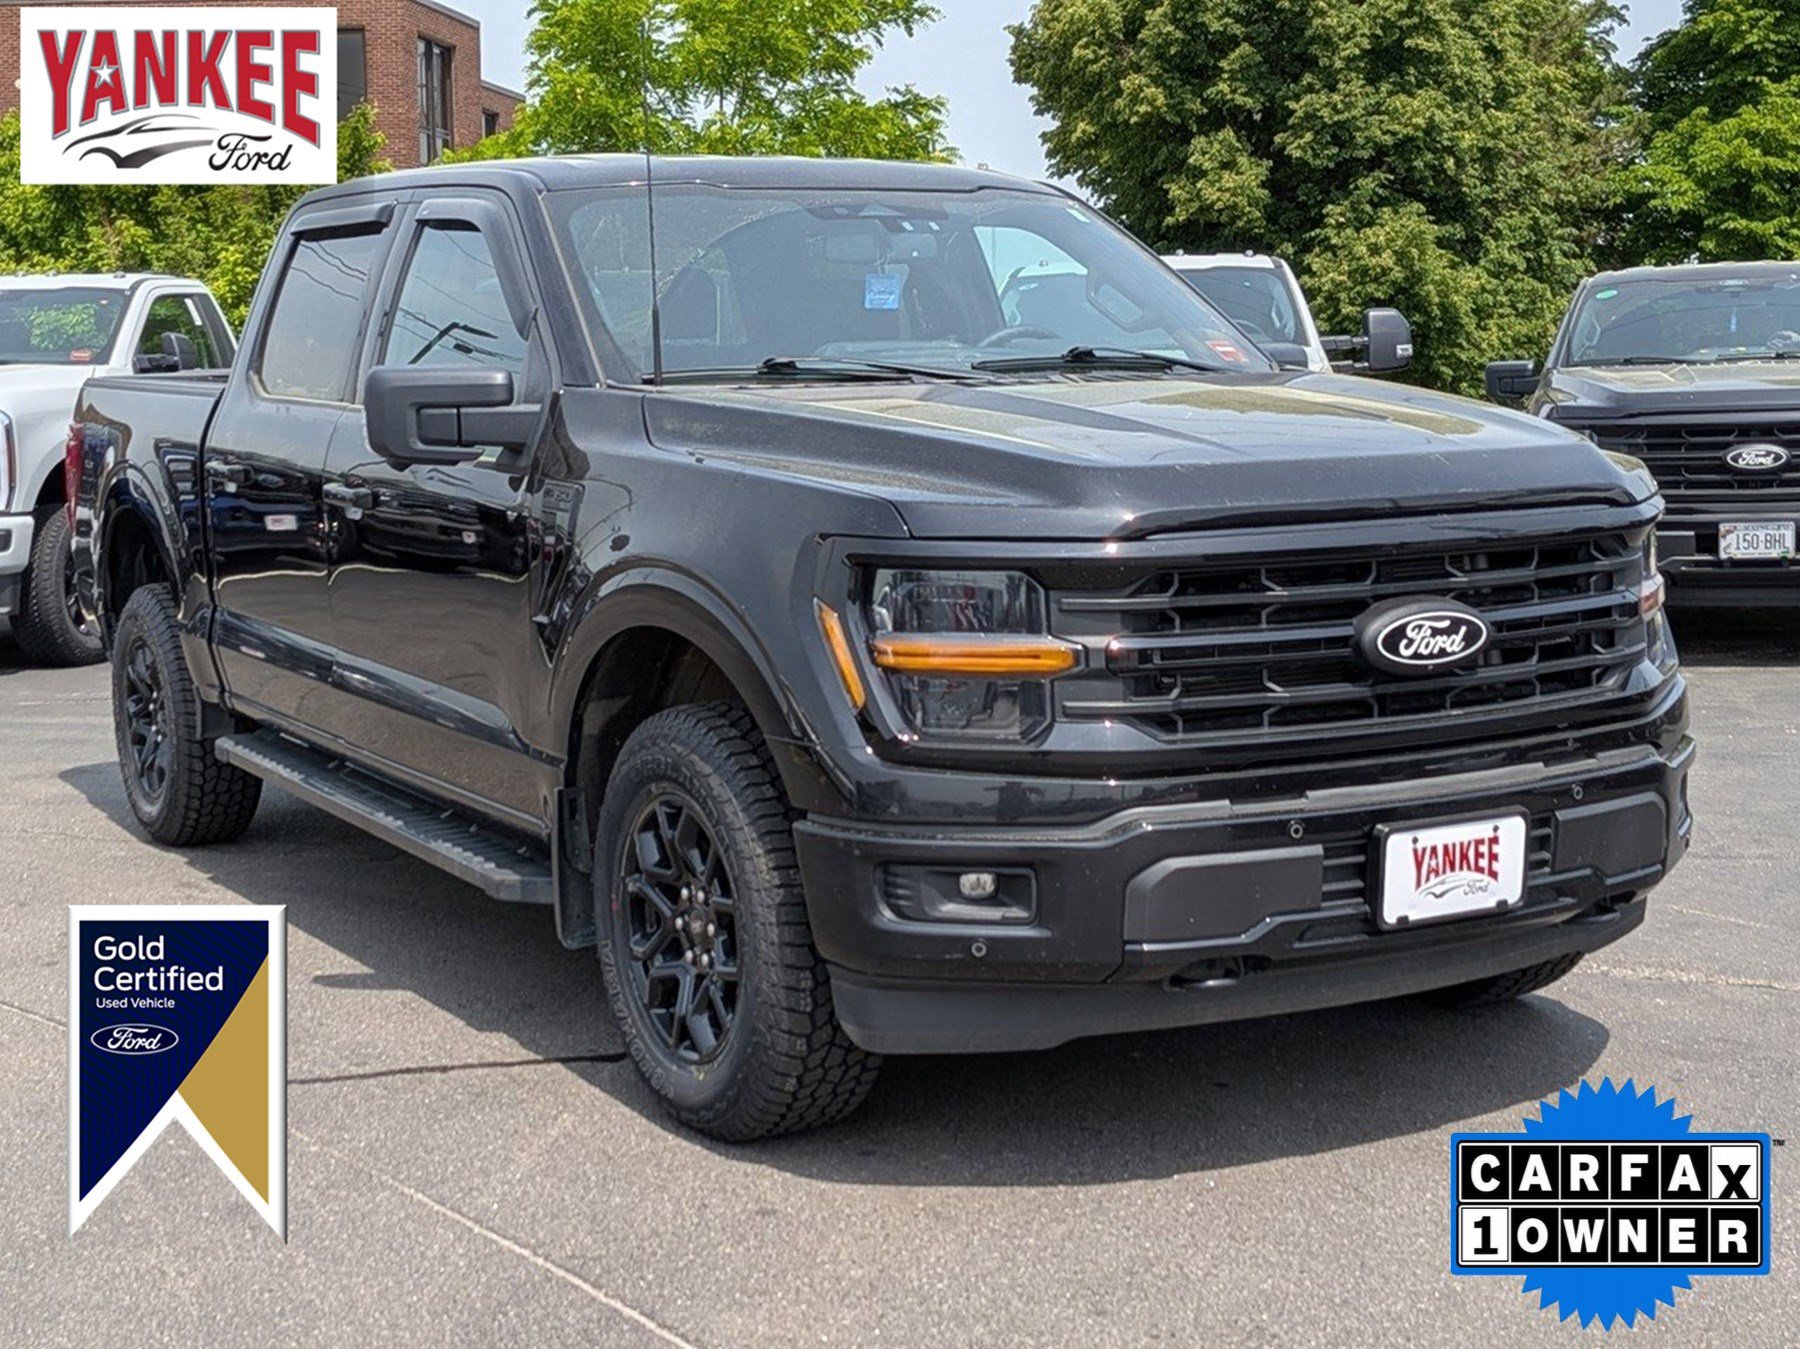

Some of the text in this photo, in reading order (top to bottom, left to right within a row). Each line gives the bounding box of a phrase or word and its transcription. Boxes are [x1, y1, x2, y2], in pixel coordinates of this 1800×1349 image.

[1738, 450, 1775, 465] Ford
[1399, 619, 1467, 657] Ford
[1412, 835, 1499, 892] YANKEE
[1463, 879, 1491, 896] Ford
